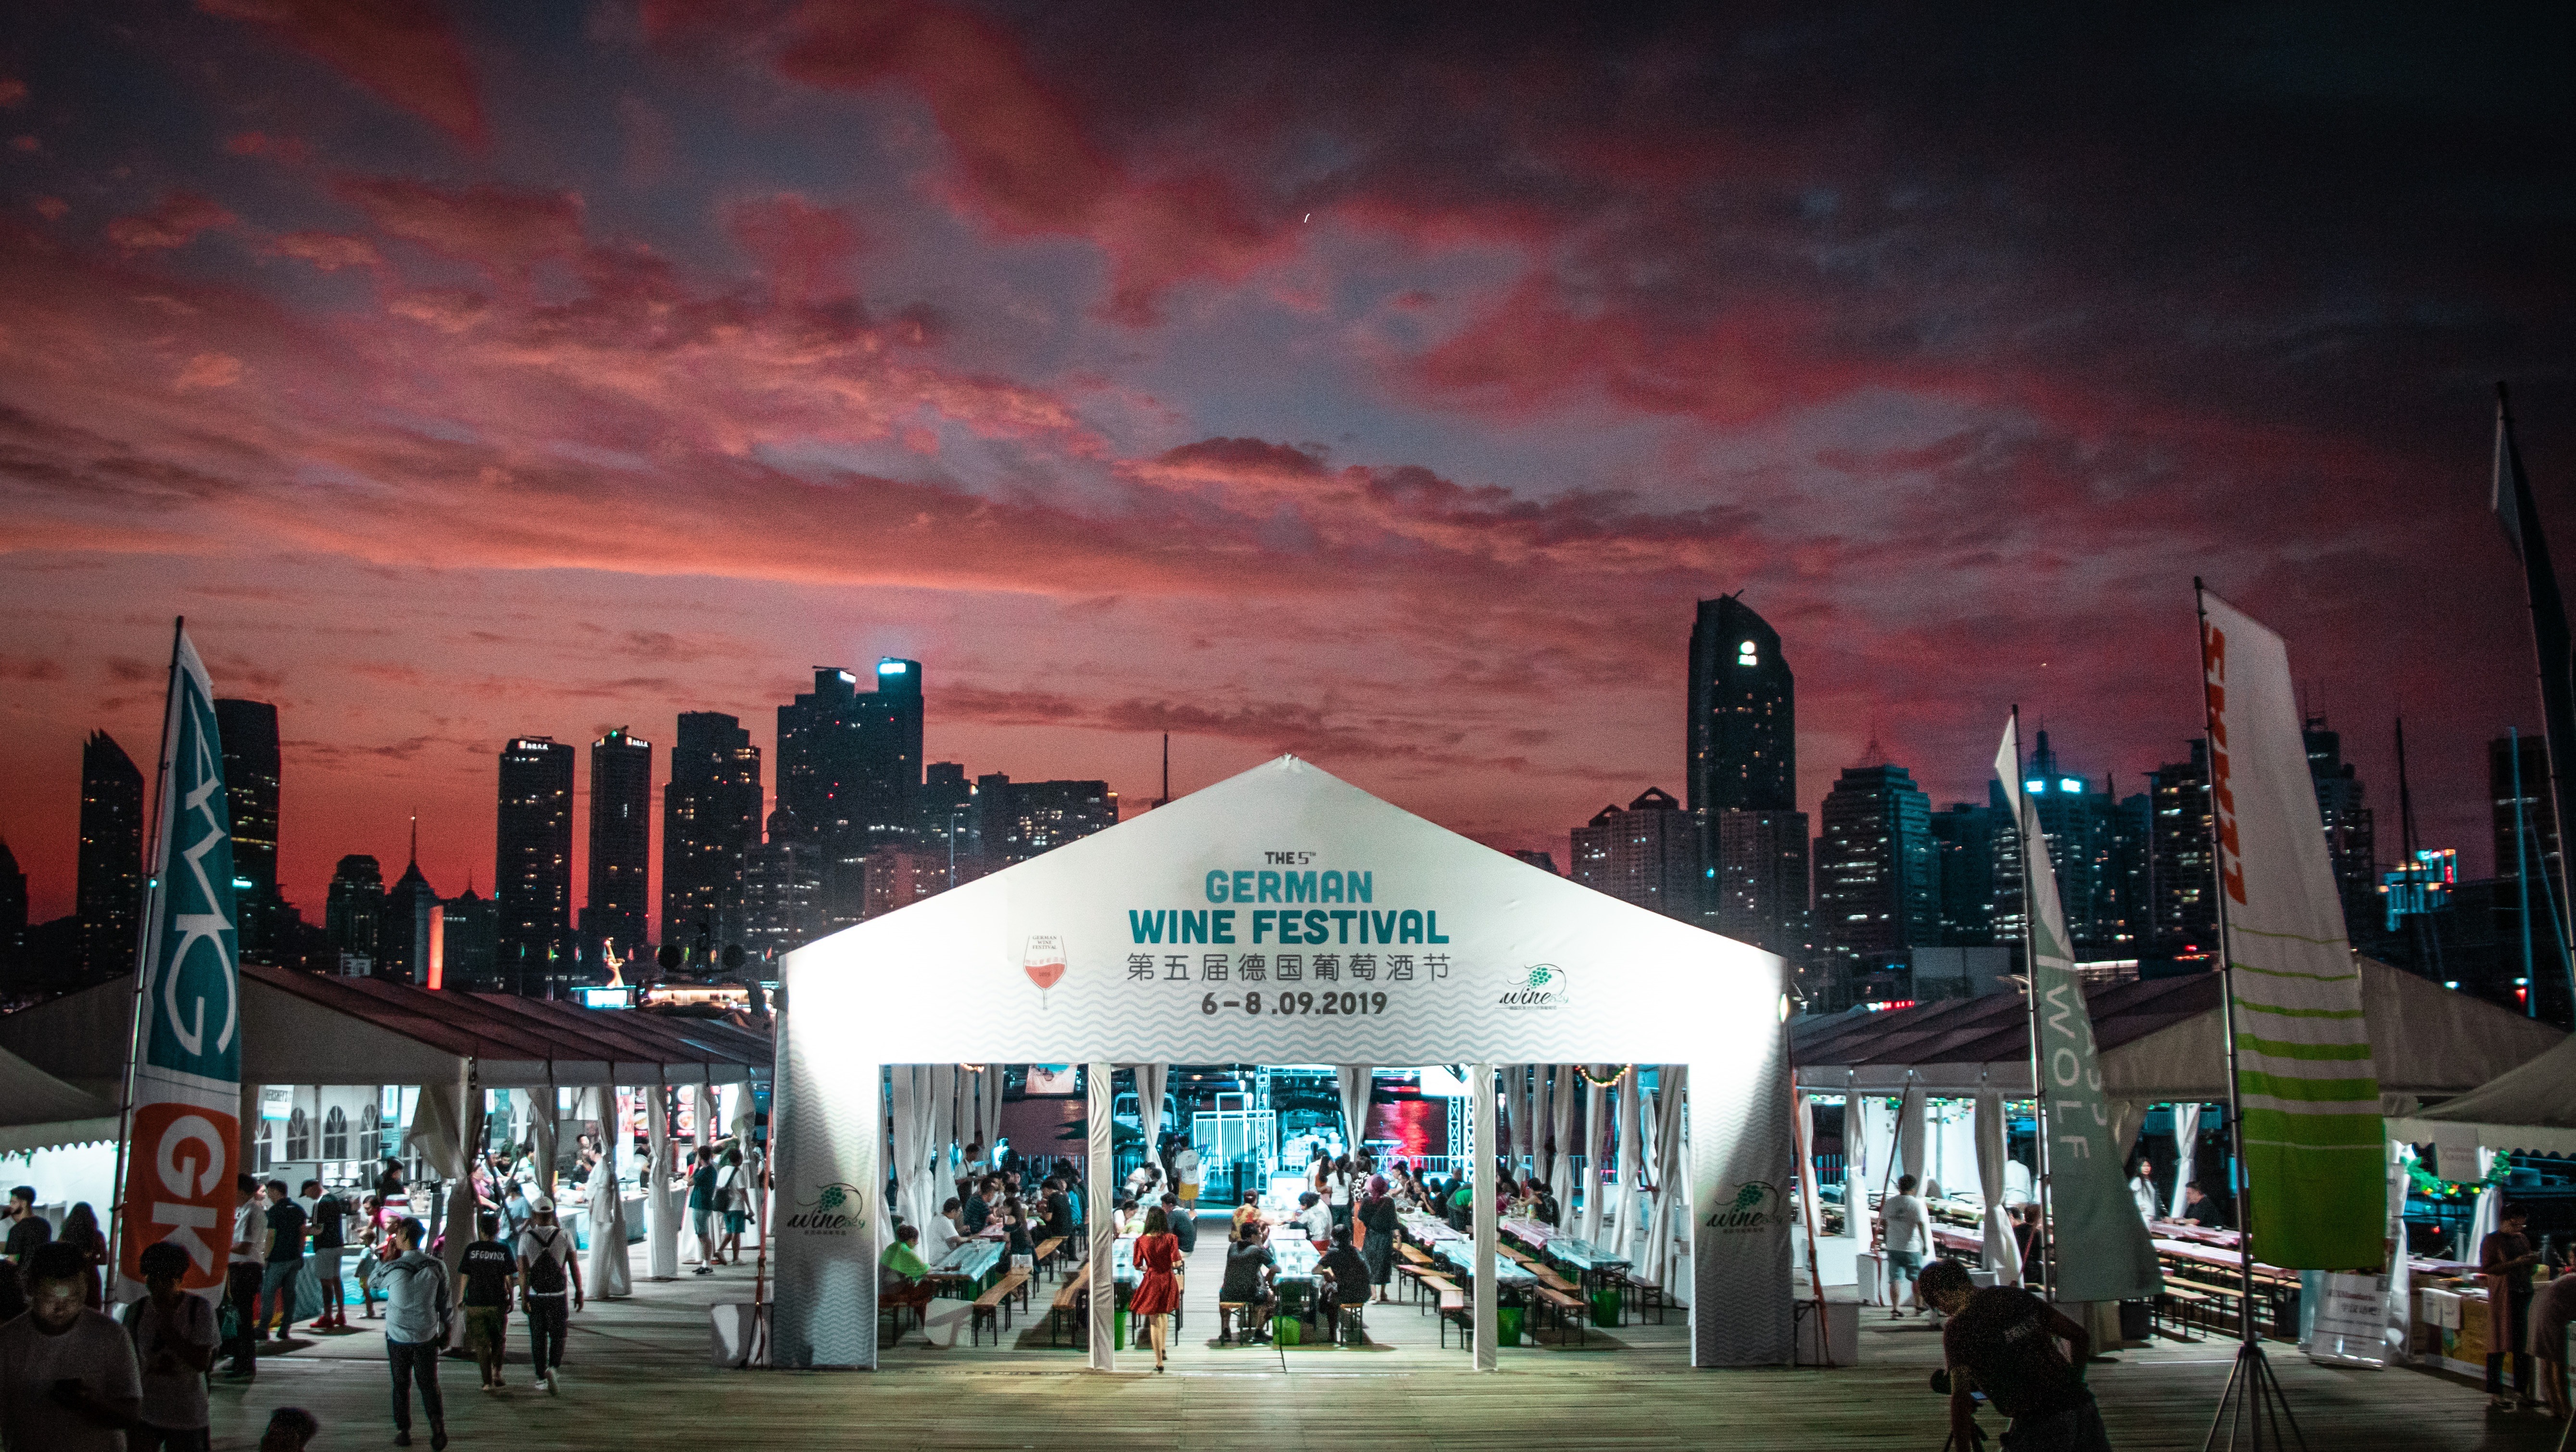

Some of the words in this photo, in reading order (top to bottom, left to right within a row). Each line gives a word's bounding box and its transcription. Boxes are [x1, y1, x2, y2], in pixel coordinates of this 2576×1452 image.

[1264, 851, 1295, 864] THE
[1205, 869, 1373, 904] GERMAN
[1128, 908, 1236, 946] WINE
[1252, 908, 1450, 946] FESTIVAL
[1126, 952, 1451, 983] 第五届德国葡萄酒节
[2046, 983, 2090, 1159] WOLF
[152, 1114, 226, 1277] GK
